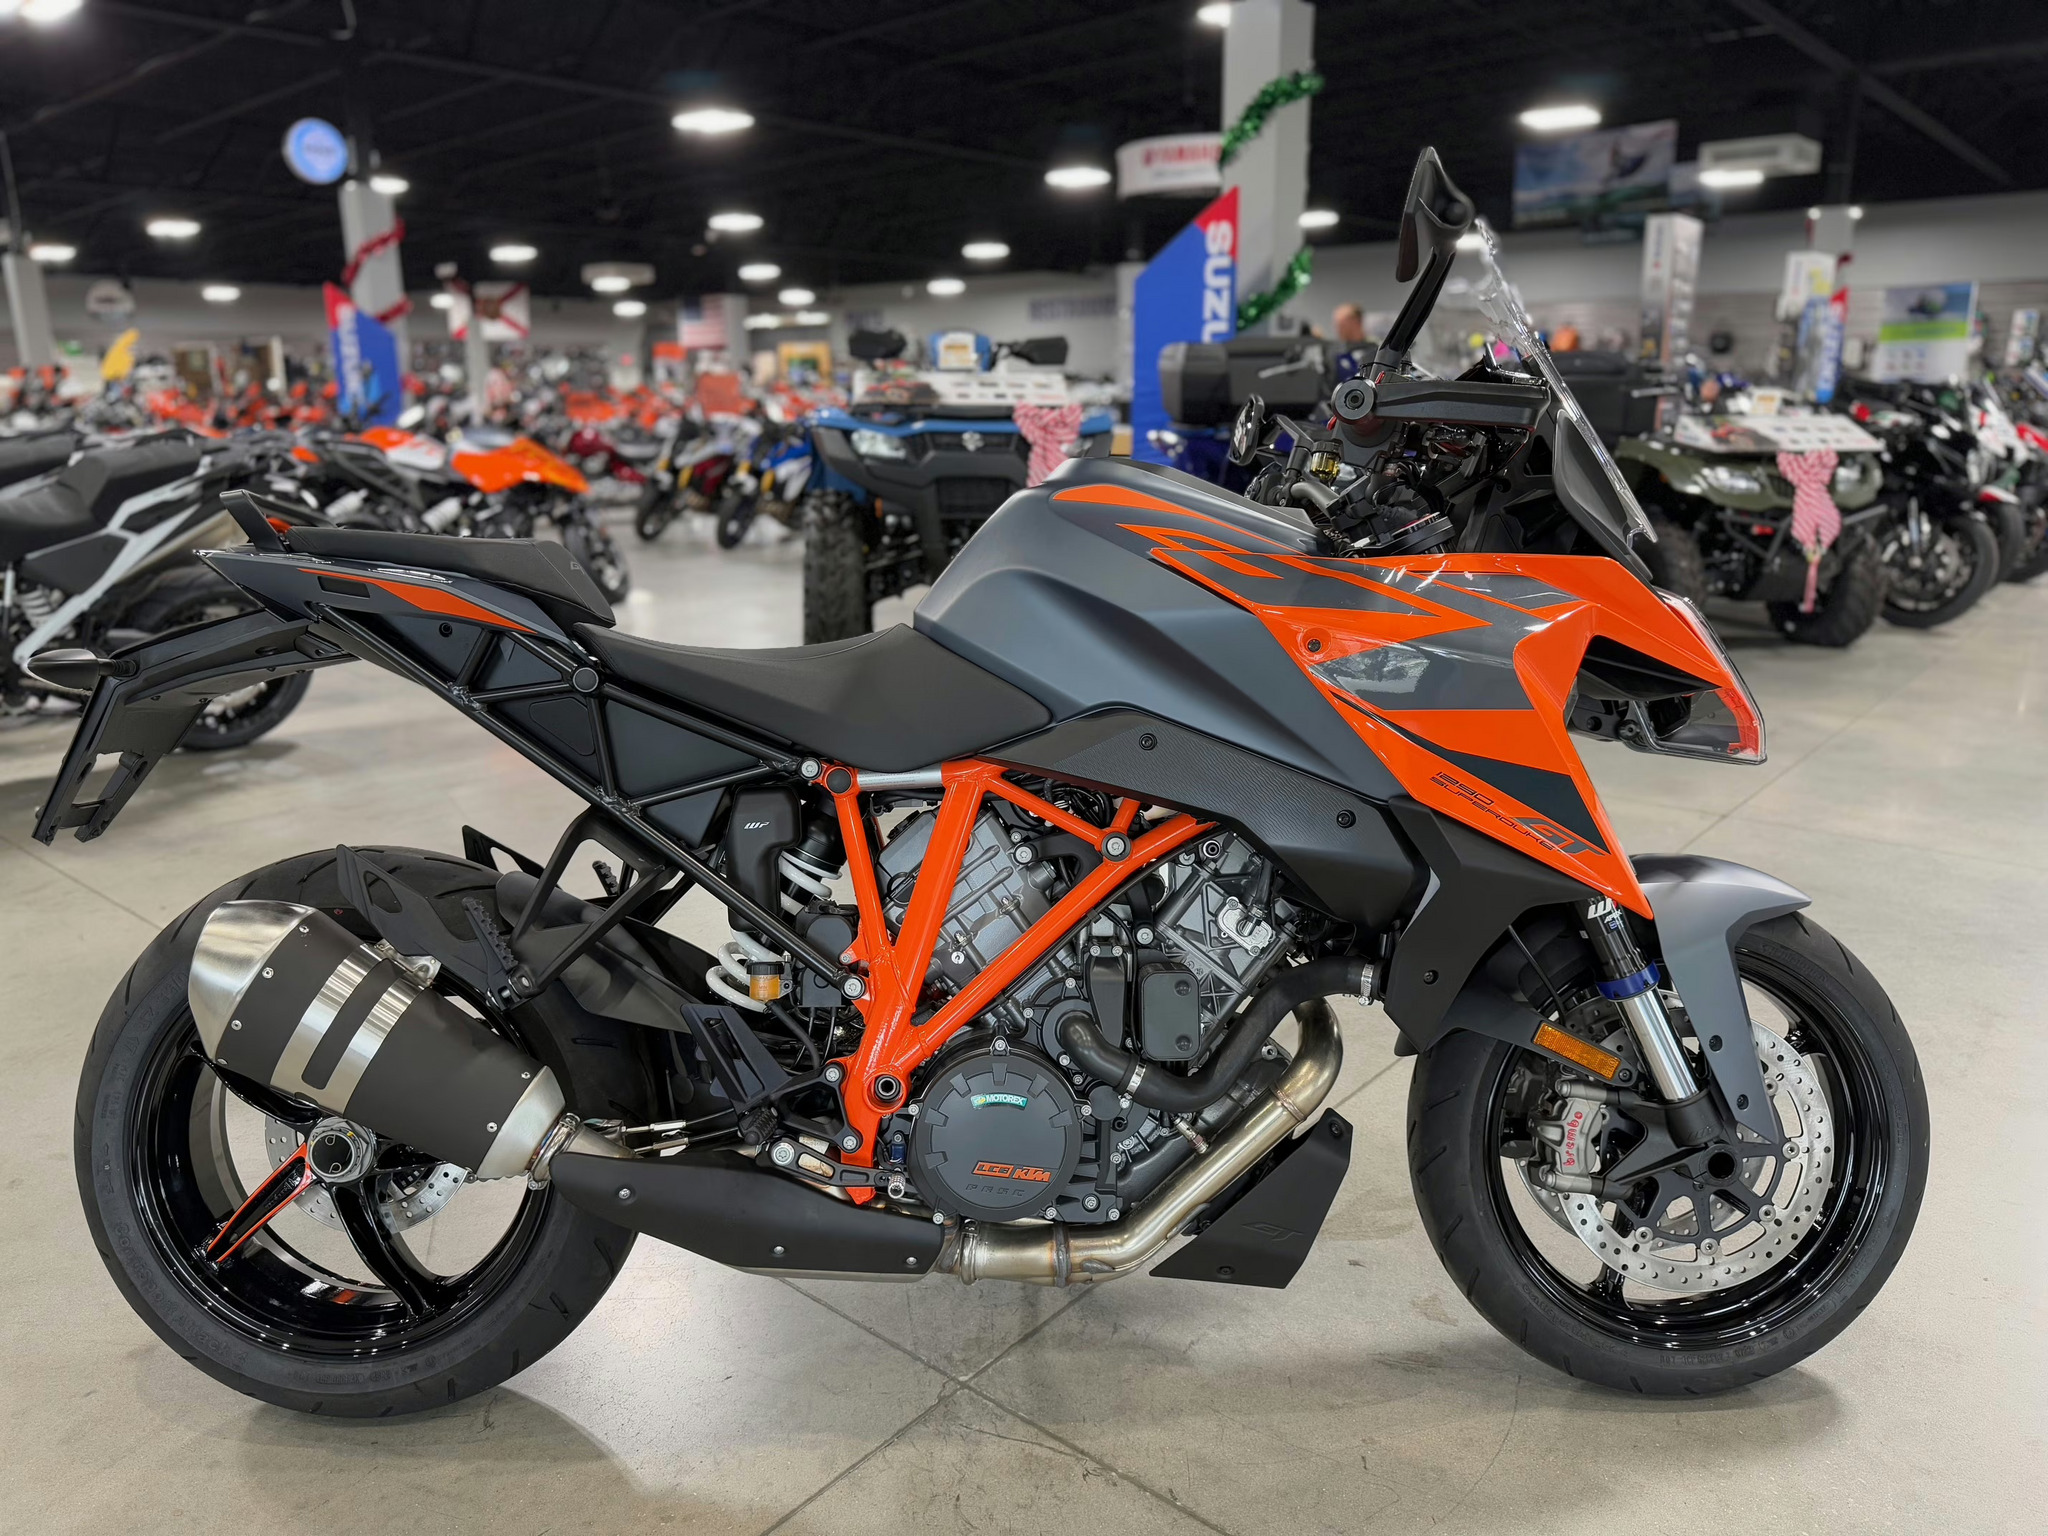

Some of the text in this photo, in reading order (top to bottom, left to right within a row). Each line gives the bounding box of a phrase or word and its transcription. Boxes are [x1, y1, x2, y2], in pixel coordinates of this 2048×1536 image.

[1202, 220, 1233, 343] SUZU
[1513, 816, 1606, 857] GT
[986, 1094, 1024, 1106] MOTOREX
[1563, 1111, 1583, 1167] brembo
[1012, 1166, 1051, 1182] KTM
